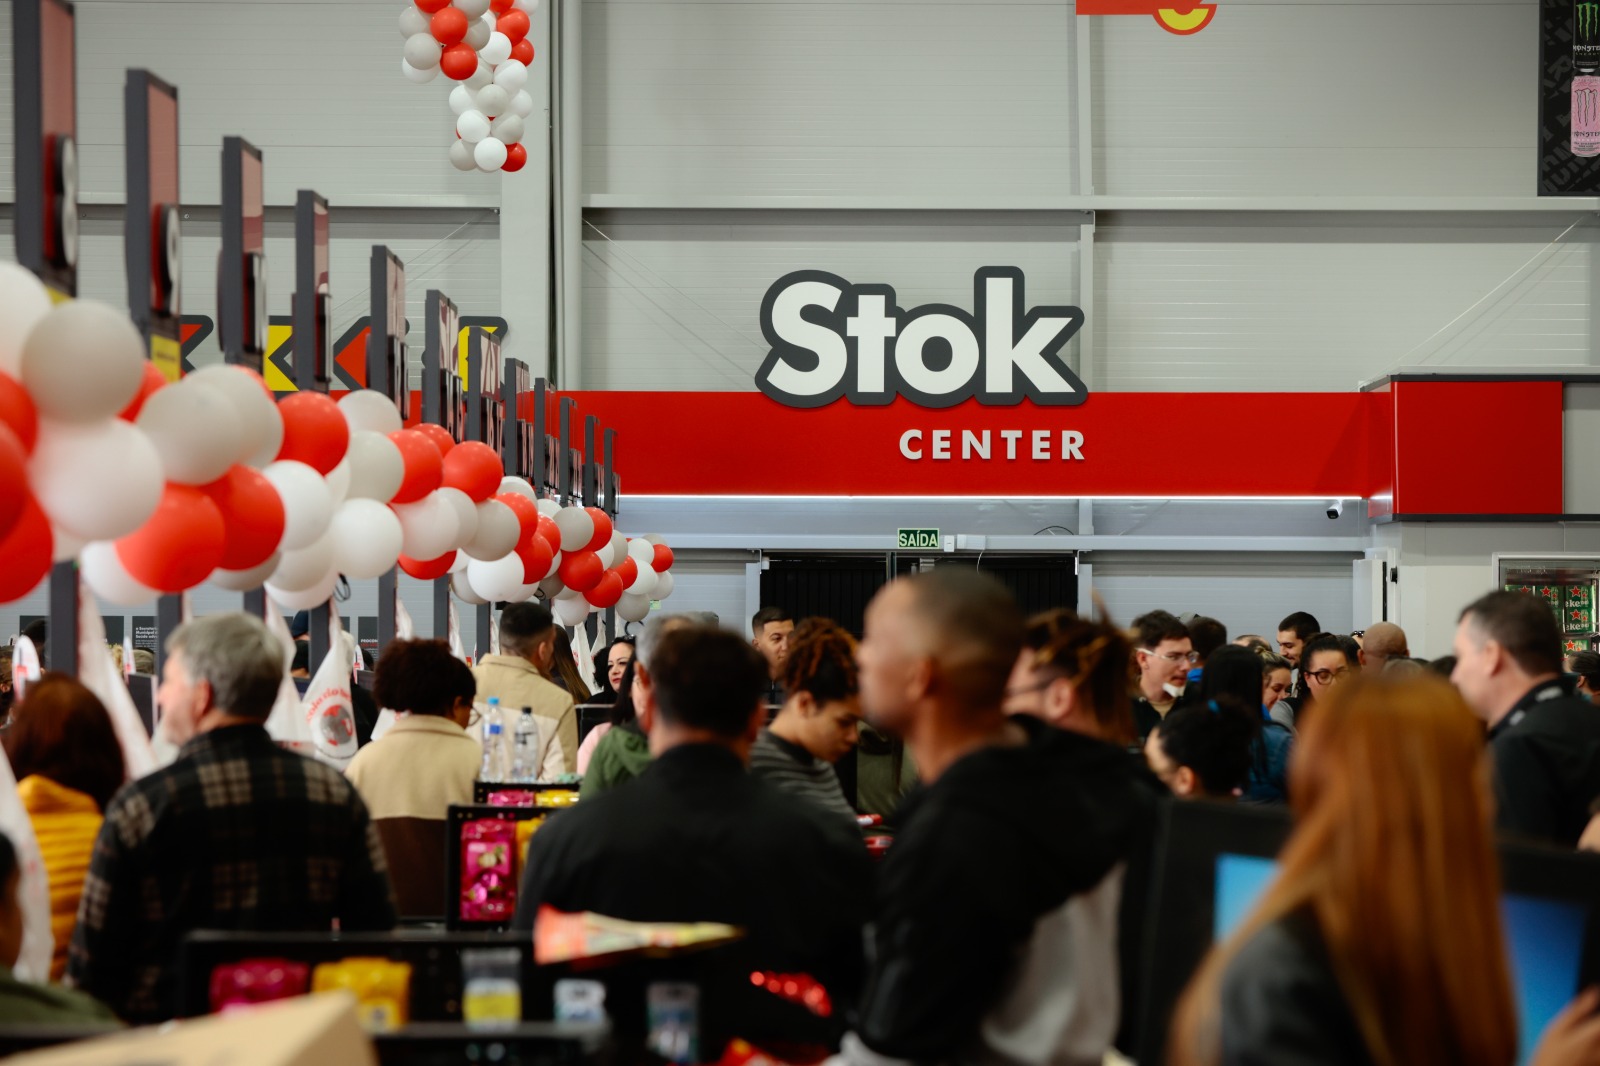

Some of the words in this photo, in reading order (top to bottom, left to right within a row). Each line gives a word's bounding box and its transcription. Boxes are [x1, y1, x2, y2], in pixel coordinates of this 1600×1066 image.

[1572, 45, 1600, 53] MONSTE
[766, 277, 1077, 396] Stok
[899, 429, 1085, 461] CENTER
[899, 530, 938, 547] SAÍDA
